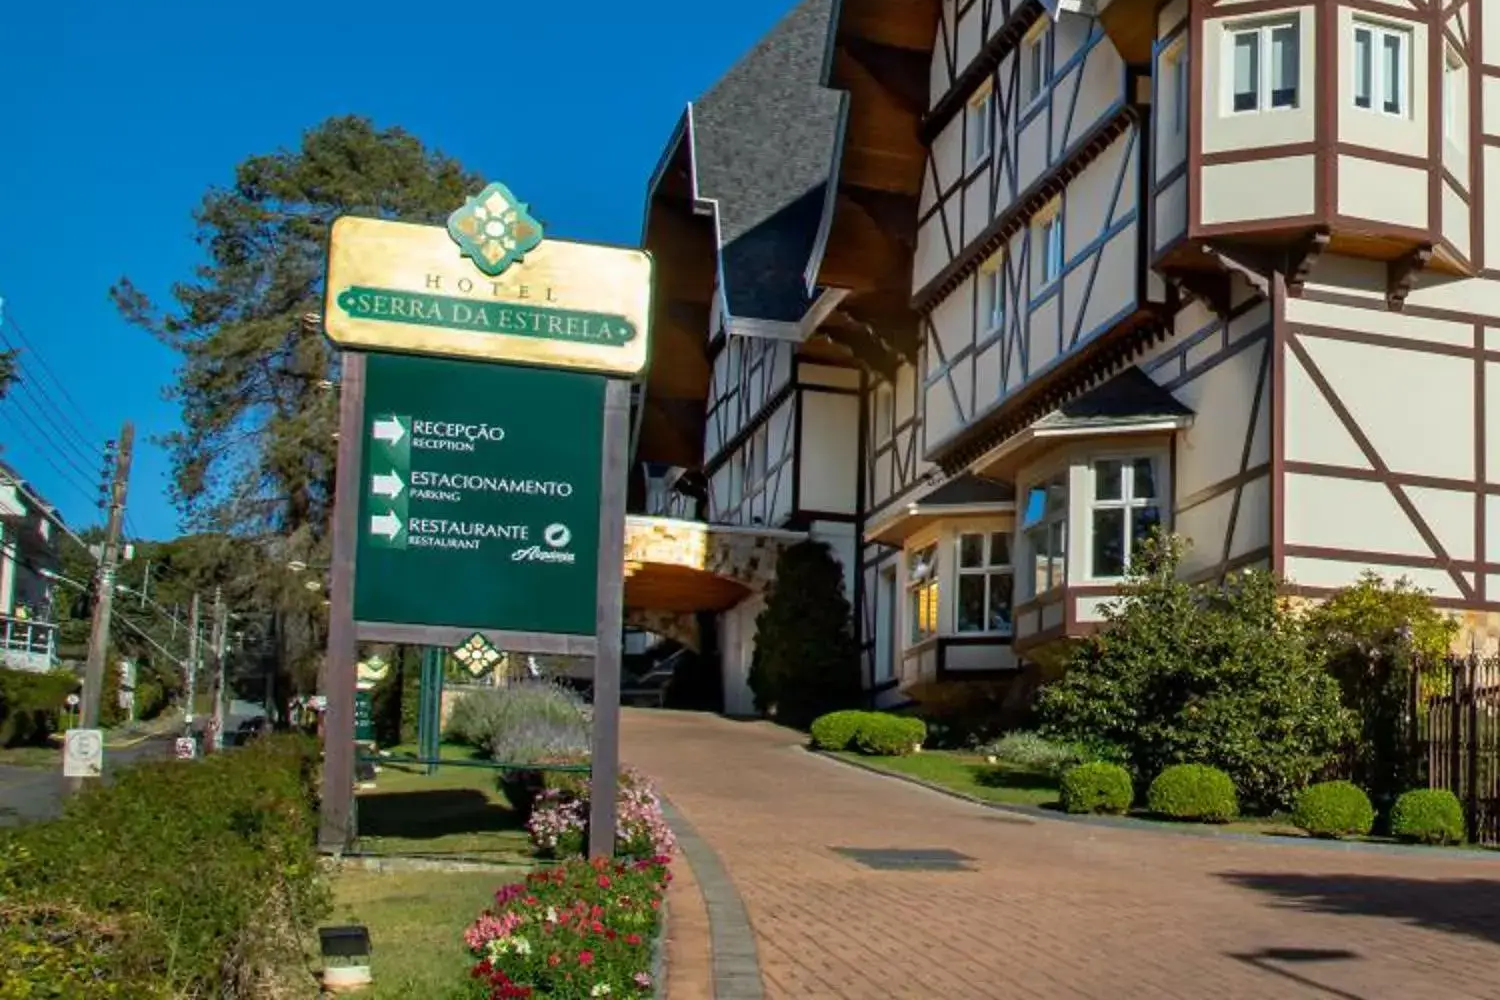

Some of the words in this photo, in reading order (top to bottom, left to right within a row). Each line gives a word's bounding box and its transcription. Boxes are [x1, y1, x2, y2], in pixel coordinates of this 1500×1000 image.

[426, 273, 557, 302] HOTEL
[356, 295, 443, 322] SERRA
[452, 305, 490, 328] DA
[499, 309, 612, 340] ESTRELA
[413, 420, 505, 442] RECEPÇÃO
[412, 438, 475, 451] RECEPTION
[410, 471, 573, 497] ESTACIONAMENTO
[409, 489, 461, 502] PARKING
[408, 518, 529, 540] RESTAURANTE
[408, 536, 480, 549] RESTAURANT
